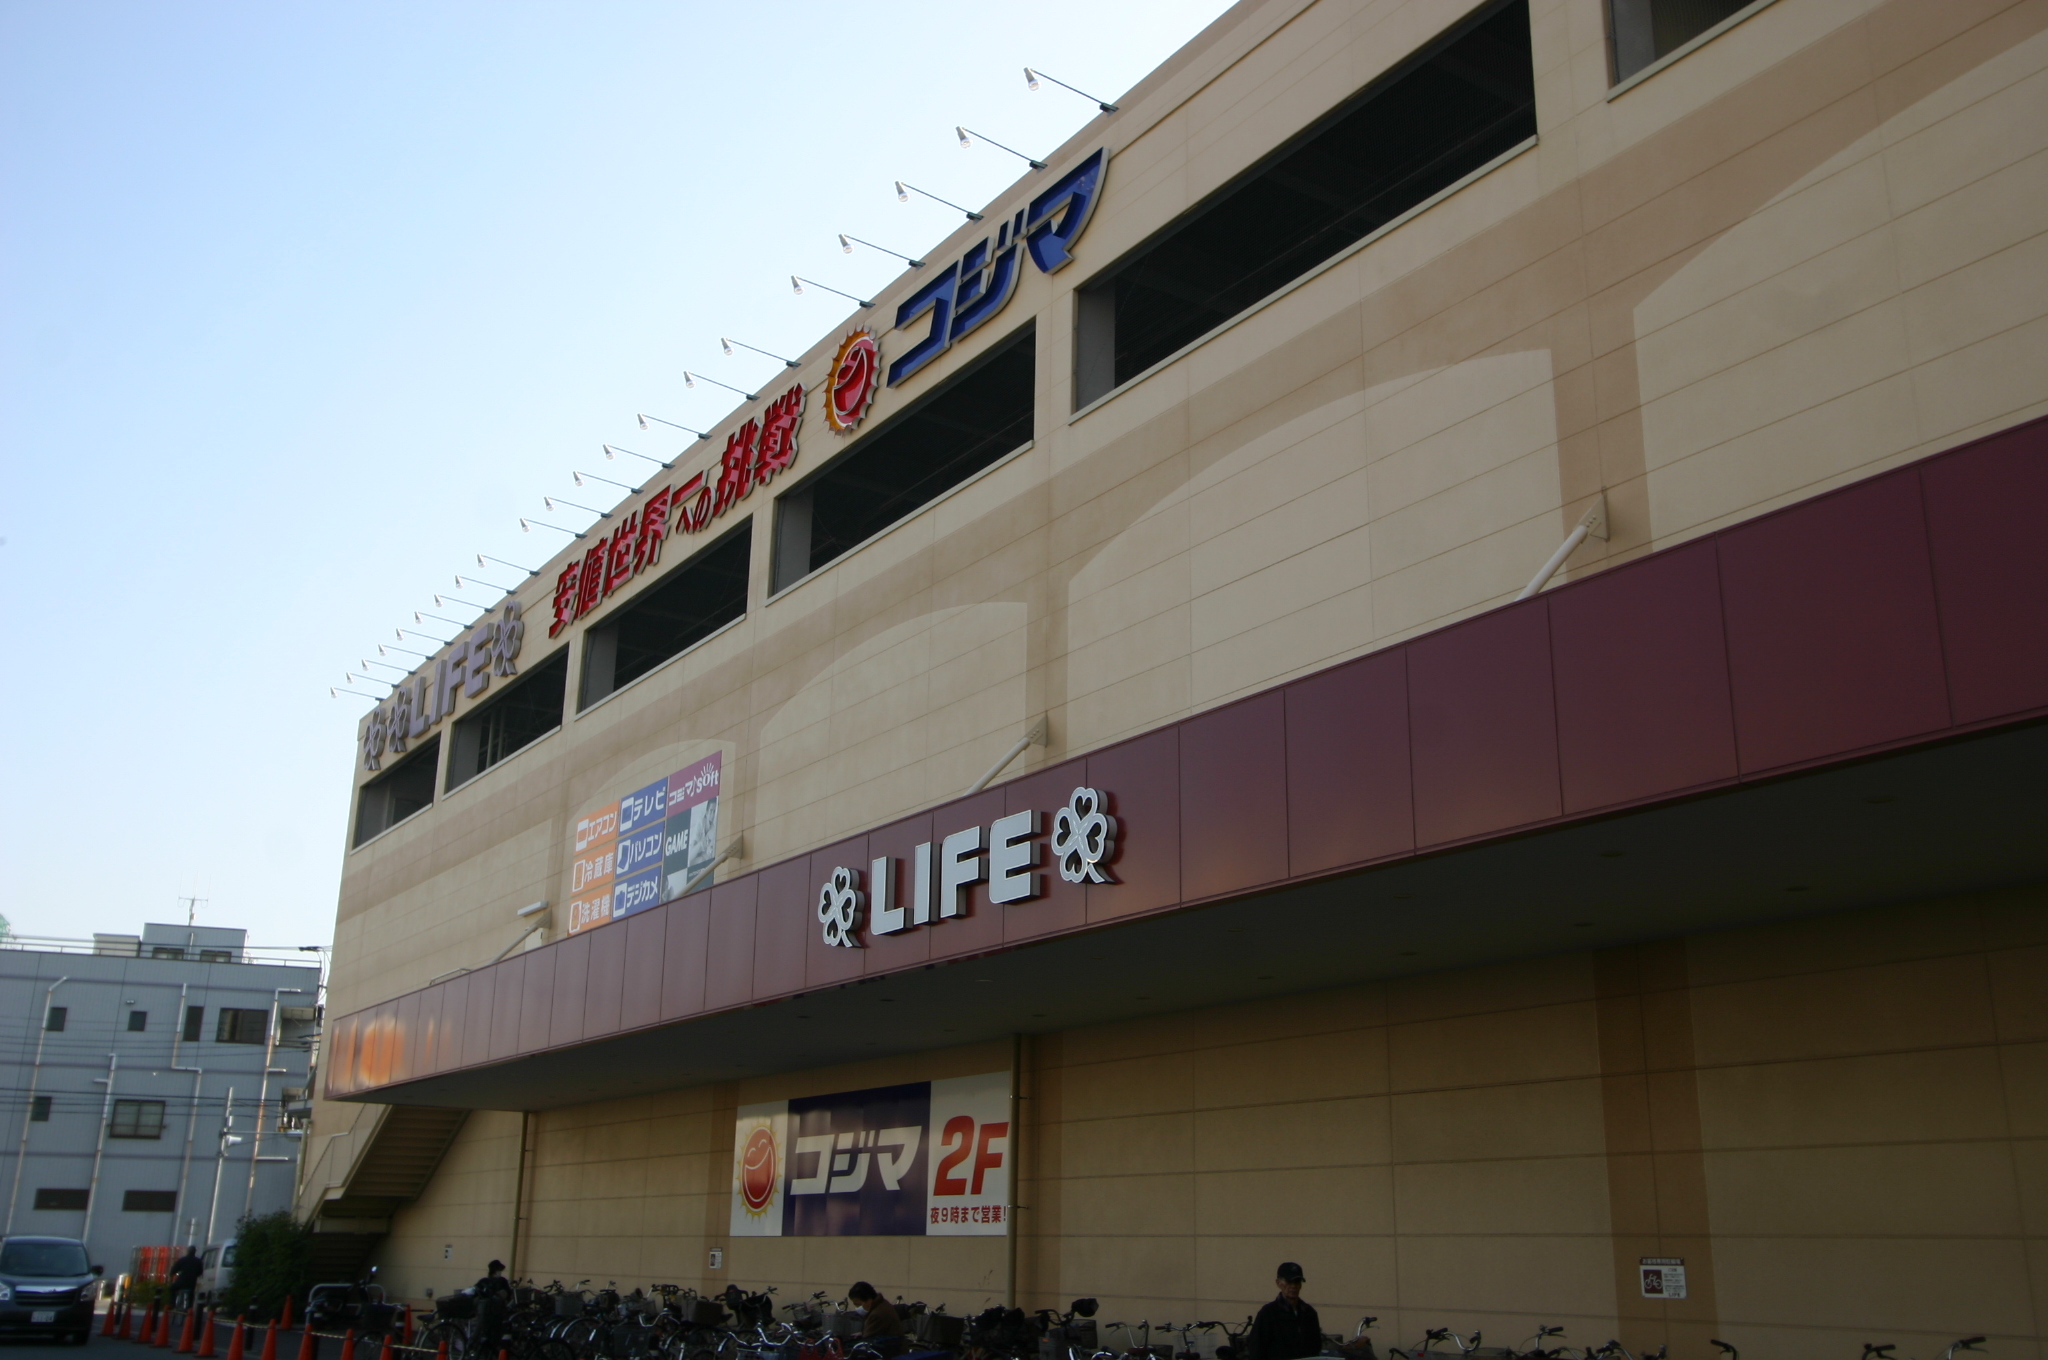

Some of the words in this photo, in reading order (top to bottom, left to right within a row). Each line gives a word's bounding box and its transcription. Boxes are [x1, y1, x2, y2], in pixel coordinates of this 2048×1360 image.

[886, 147, 1110, 388] コジマ
[548, 382, 807, 639] 安値世界一への挑戦
[408, 622, 494, 738] LIFE
[588, 811, 617, 841] エアコン
[633, 787, 665, 821] テレビ
[585, 852, 614, 882] 冷蔵庫
[630, 832, 662, 864] パソコン
[665, 829, 688, 856] GAME
[626, 876, 659, 908] デジカメ
[870, 809, 1042, 935] LIFE
[790, 1125, 922, 1195] コジマ
[933, 1115, 1009, 1196] 2F
